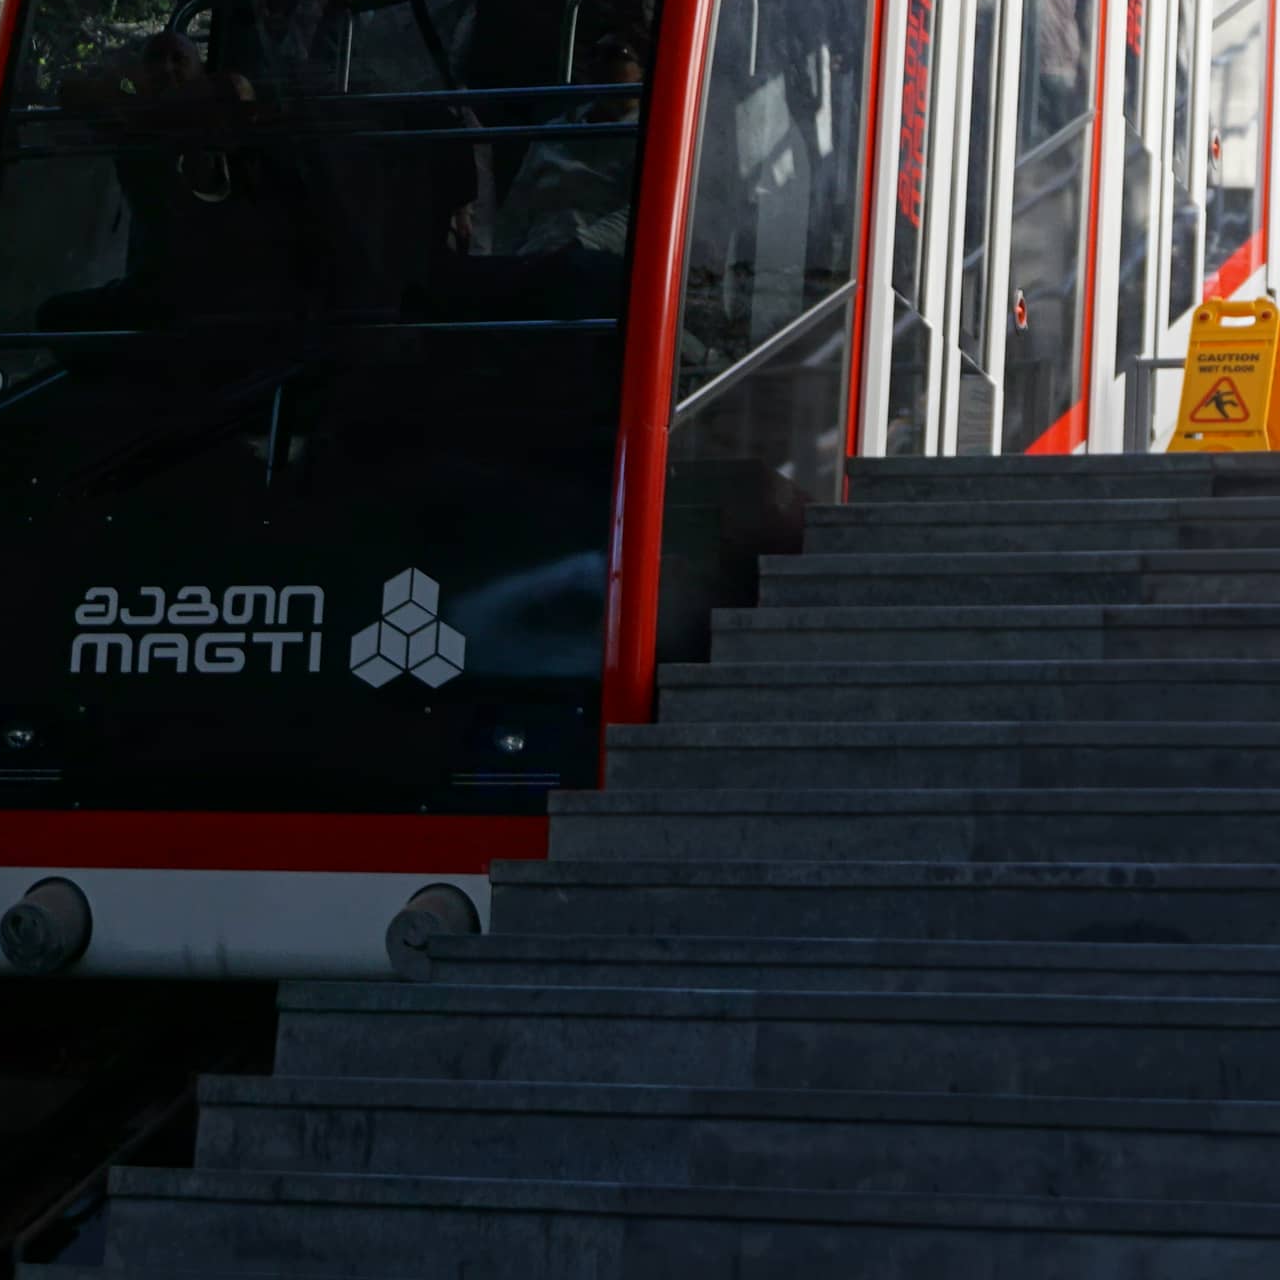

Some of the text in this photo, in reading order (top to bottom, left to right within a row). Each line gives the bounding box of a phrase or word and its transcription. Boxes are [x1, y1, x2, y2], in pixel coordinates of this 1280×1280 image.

[1198, 353, 1260, 362] CAUTION
[75, 586, 325, 625] მაგთი
[71, 632, 322, 672] MAGTI
